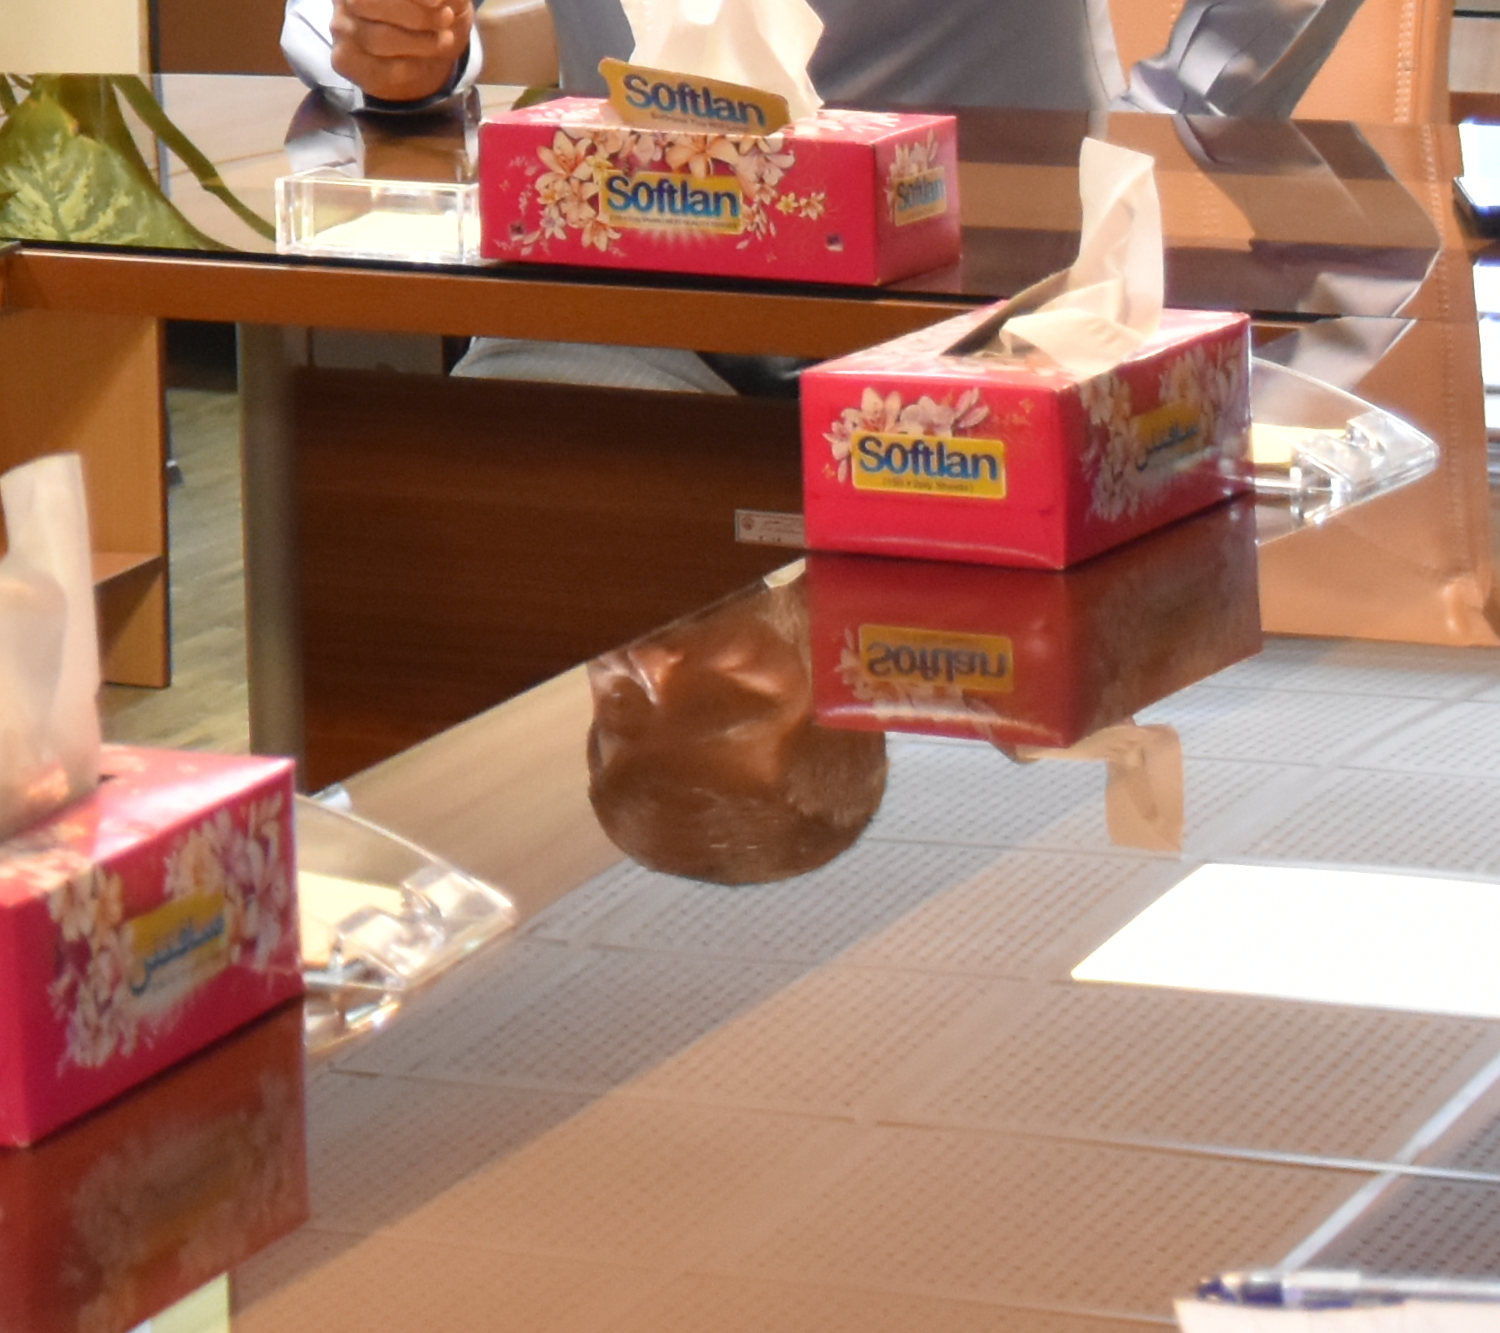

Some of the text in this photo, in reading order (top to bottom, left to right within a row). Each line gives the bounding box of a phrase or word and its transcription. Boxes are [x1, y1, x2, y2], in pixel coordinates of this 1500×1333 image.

[623, 73, 767, 128] Softlan
[606, 175, 740, 219] Softlan
[857, 435, 998, 481] Softlan
